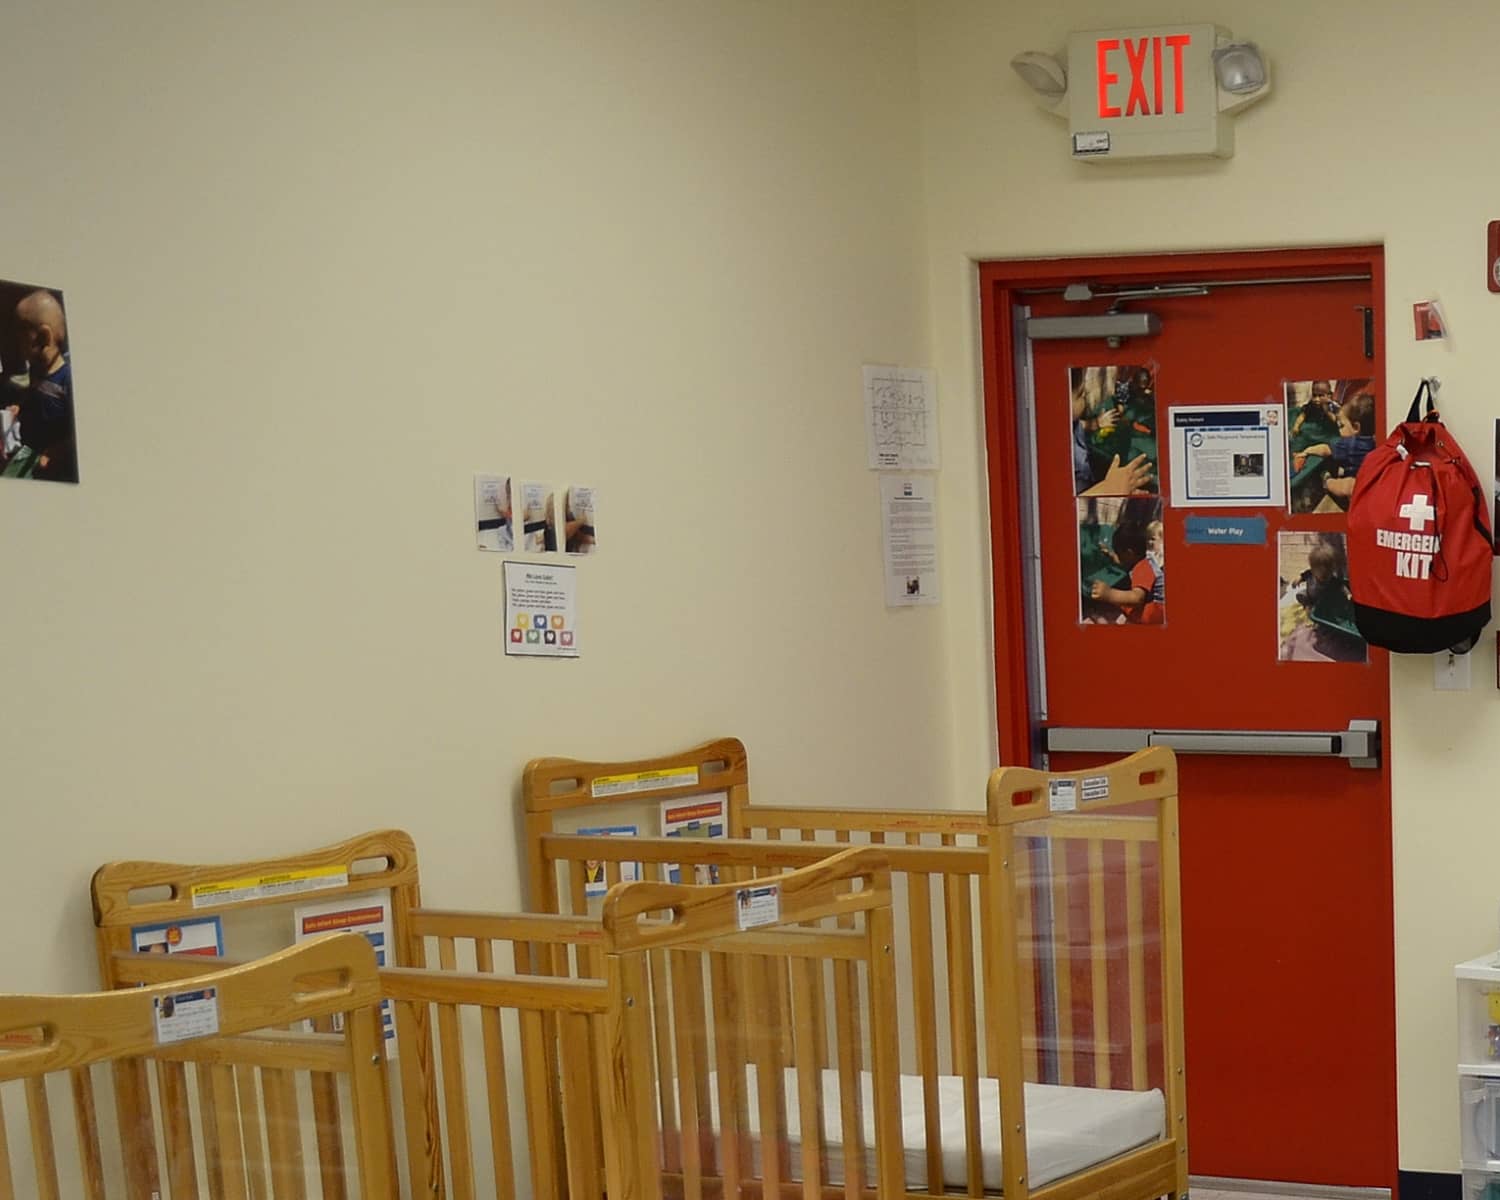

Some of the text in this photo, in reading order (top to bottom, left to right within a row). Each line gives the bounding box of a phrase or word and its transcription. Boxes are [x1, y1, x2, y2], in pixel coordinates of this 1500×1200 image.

[1096, 34, 1190, 118] EXIT
[1207, 527, 1245, 537] Water Play
[1376, 528, 1442, 554] EMERGEN
[1396, 551, 1433, 580] KIT
